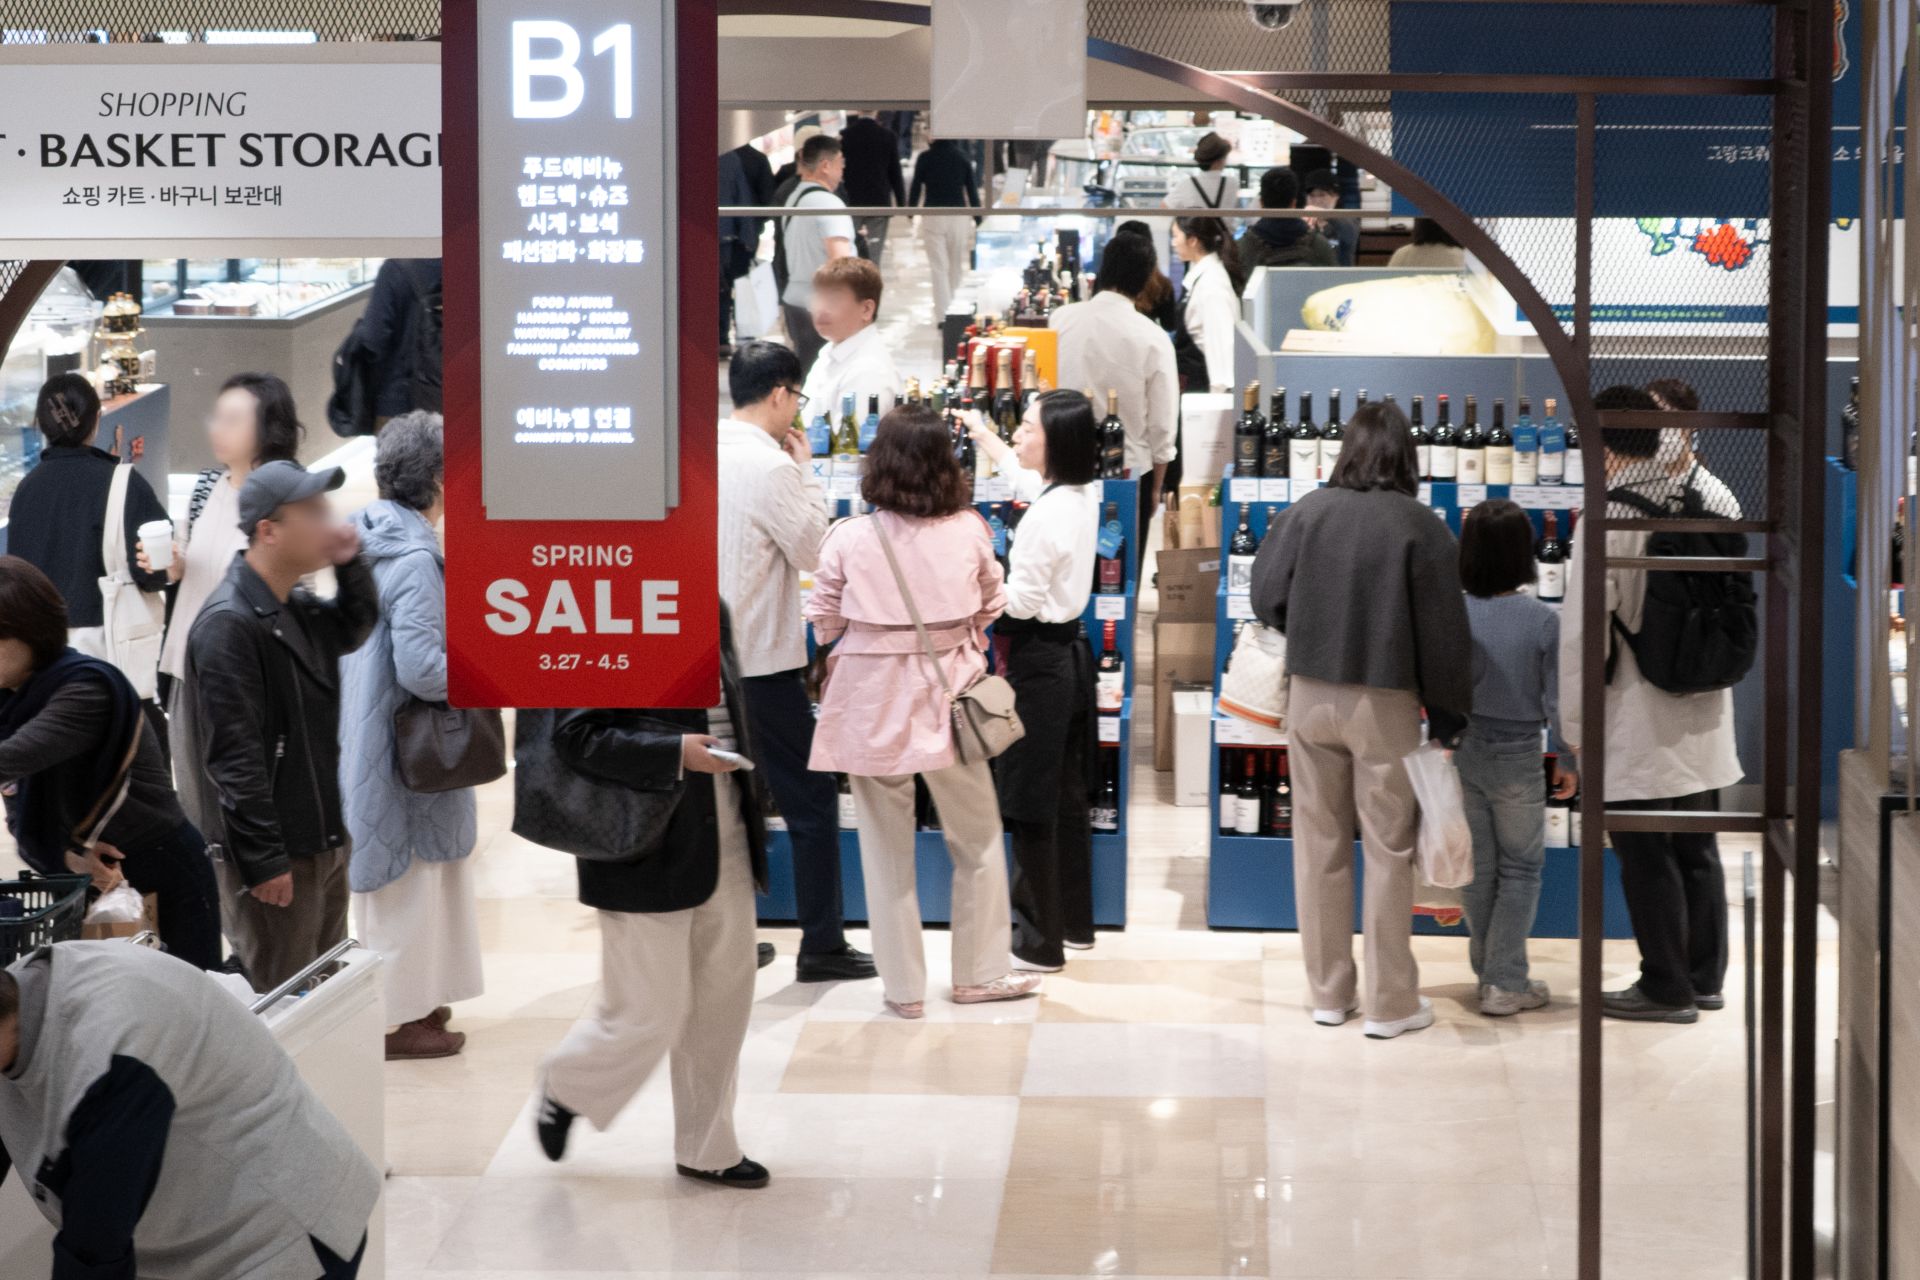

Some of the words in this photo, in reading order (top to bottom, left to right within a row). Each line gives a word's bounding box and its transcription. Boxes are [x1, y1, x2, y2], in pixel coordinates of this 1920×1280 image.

[511, 20, 635, 119] B1
[99, 91, 246, 117] SHOPPING
[41, 133, 225, 168] BASKET
[239, 132, 442, 168] STORAG
[522, 156, 623, 180] 푸드에비뉴
[63, 185, 100, 206] 쇼핑
[224, 185, 282, 206] 보관대
[532, 545, 633, 567] SPRING
[485, 578, 680, 636] SALE
[539, 654, 580, 670] 3.27
[597, 654, 629, 670] 4.5
